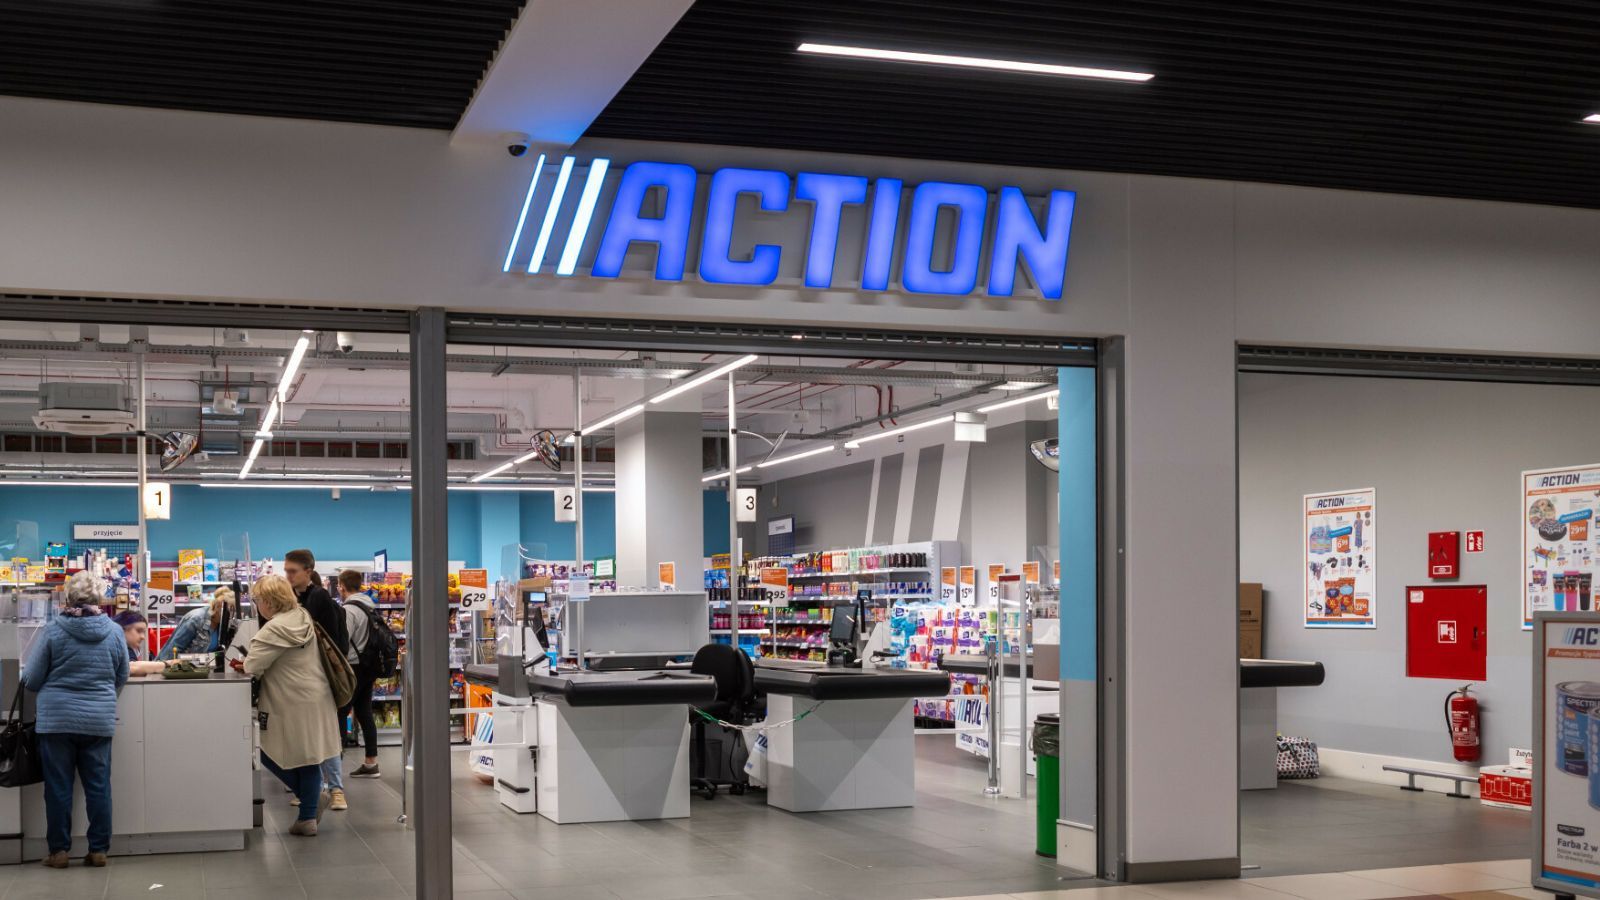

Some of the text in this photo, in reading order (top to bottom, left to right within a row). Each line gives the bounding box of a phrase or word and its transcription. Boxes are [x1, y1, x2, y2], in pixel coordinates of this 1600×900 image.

[591, 161, 1077, 300] ACTION
[1541, 473, 1580, 488] ACTION
[154, 490, 162, 506] 1
[563, 494, 573, 510] 2
[745, 495, 755, 511] 3
[1317, 497, 1345, 508] ACTION
[93, 529, 123, 537] przyjęcie
[1571, 627, 1600, 646] AC
[1557, 838, 1599, 853] Farba 2 w
